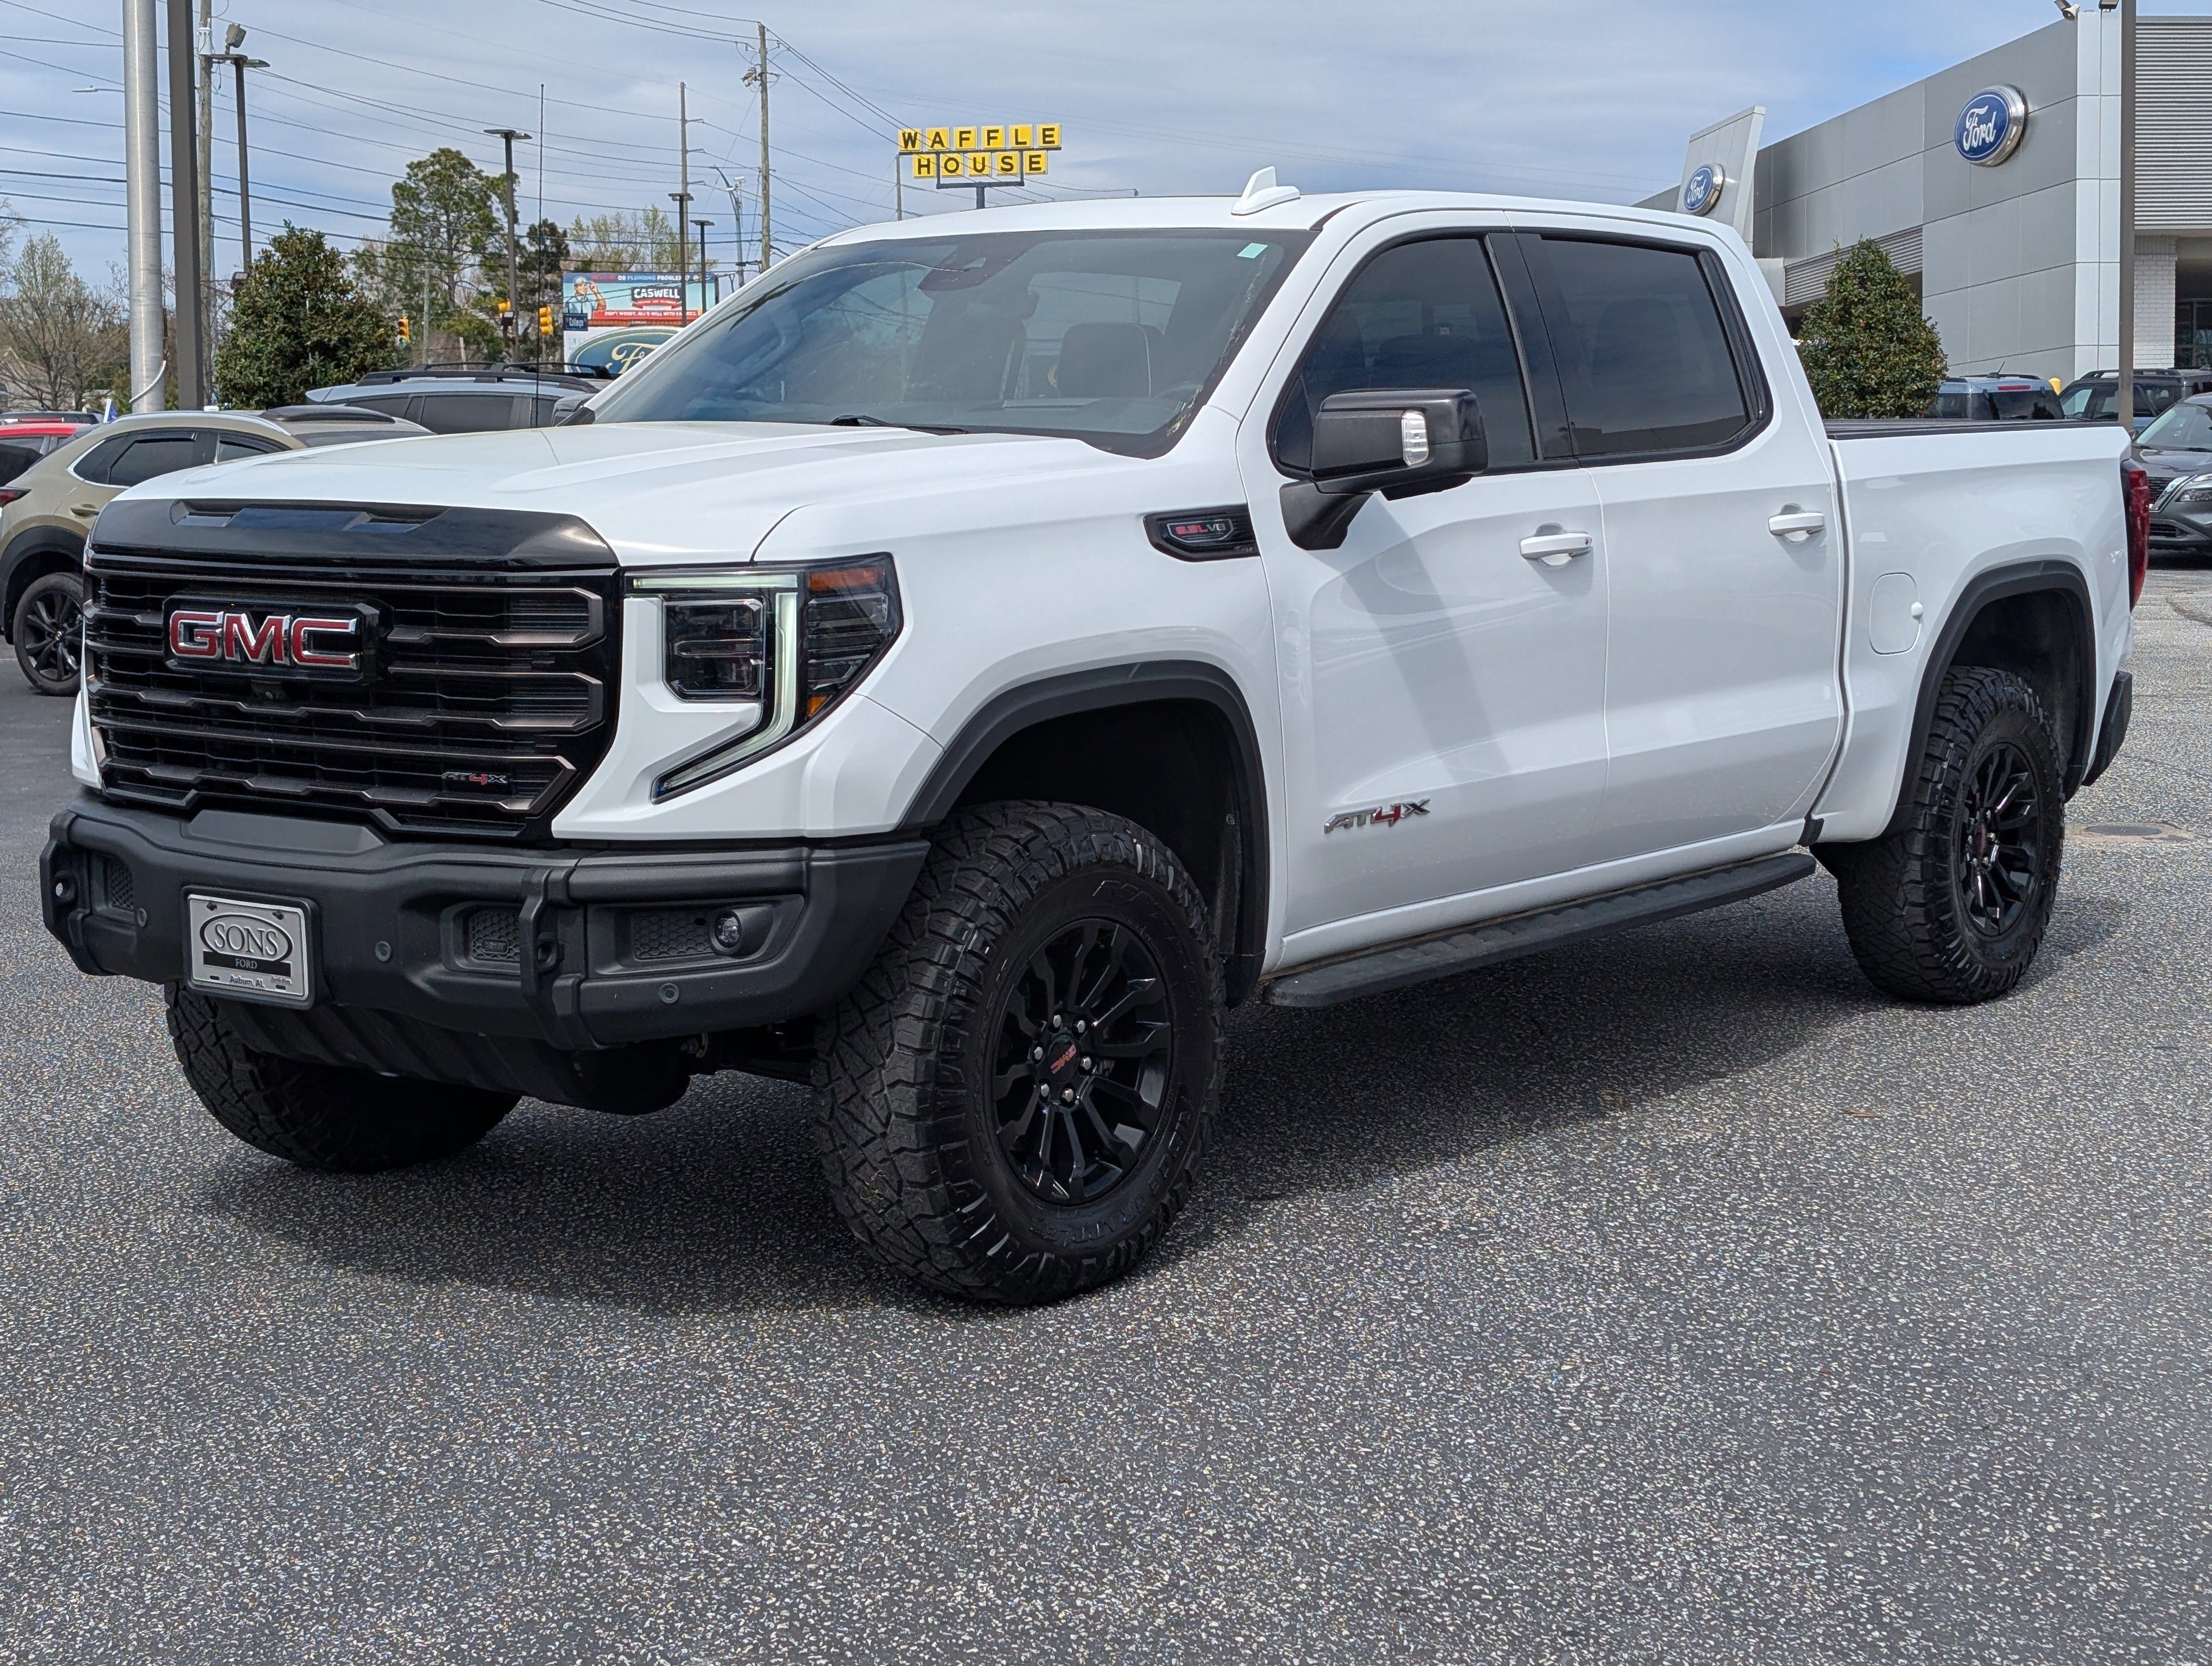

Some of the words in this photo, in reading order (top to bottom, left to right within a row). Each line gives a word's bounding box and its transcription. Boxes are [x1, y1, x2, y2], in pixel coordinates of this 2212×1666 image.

[902, 127, 1056, 149] WAFFLE
[1963, 105, 1997, 151] Ford
[917, 154, 1042, 175] HOUSE
[1687, 175, 1707, 203] Ford
[634, 289, 680, 298] CASWELL
[170, 610, 359, 669] GMC
[441, 771, 509, 785] AT4X
[1324, 797, 1431, 834] AT4X
[215, 922, 279, 956] SONS
[235, 958, 258, 969] FORD
[1051, 1044, 1076, 1074] GMC
